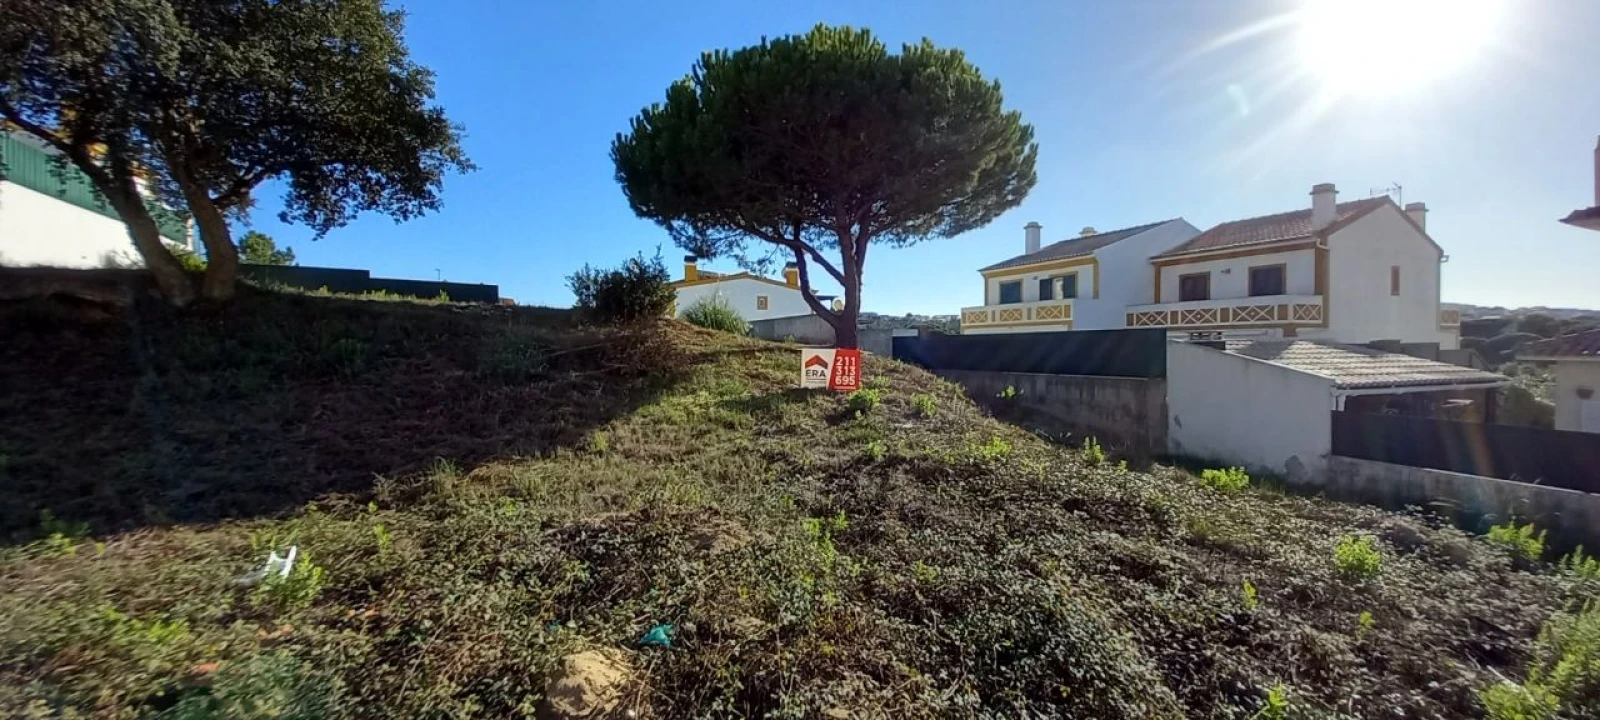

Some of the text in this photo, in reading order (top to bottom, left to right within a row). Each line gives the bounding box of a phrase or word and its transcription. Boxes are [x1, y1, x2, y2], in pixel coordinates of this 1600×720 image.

[835, 356, 856, 366] 211
[835, 366, 856, 375] 313
[835, 375, 856, 386] 695
